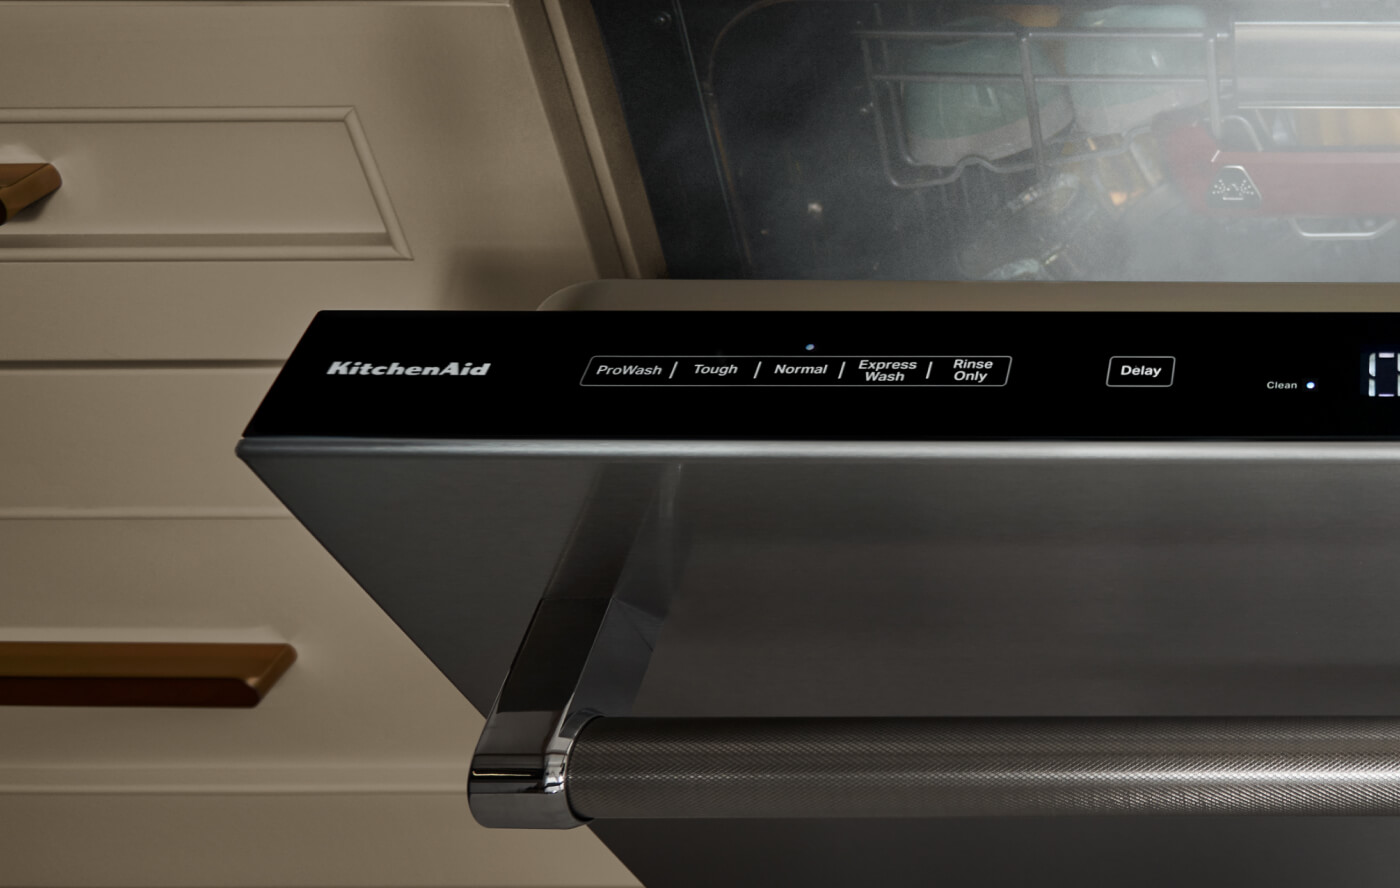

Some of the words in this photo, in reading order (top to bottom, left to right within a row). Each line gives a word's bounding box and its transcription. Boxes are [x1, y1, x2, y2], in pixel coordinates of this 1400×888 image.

[326, 361, 492, 376] KitchenAid
[596, 364, 663, 376] ProWash
[773, 364, 829, 375] Normal
[858, 359, 918, 372] Express
[952, 358, 994, 370] Rinse
[694, 364, 739, 377] Tough
[865, 371, 906, 381] Wash
[953, 370, 988, 382] Only
[1120, 364, 1162, 378] Delay
[1266, 381, 1298, 390] Clean
